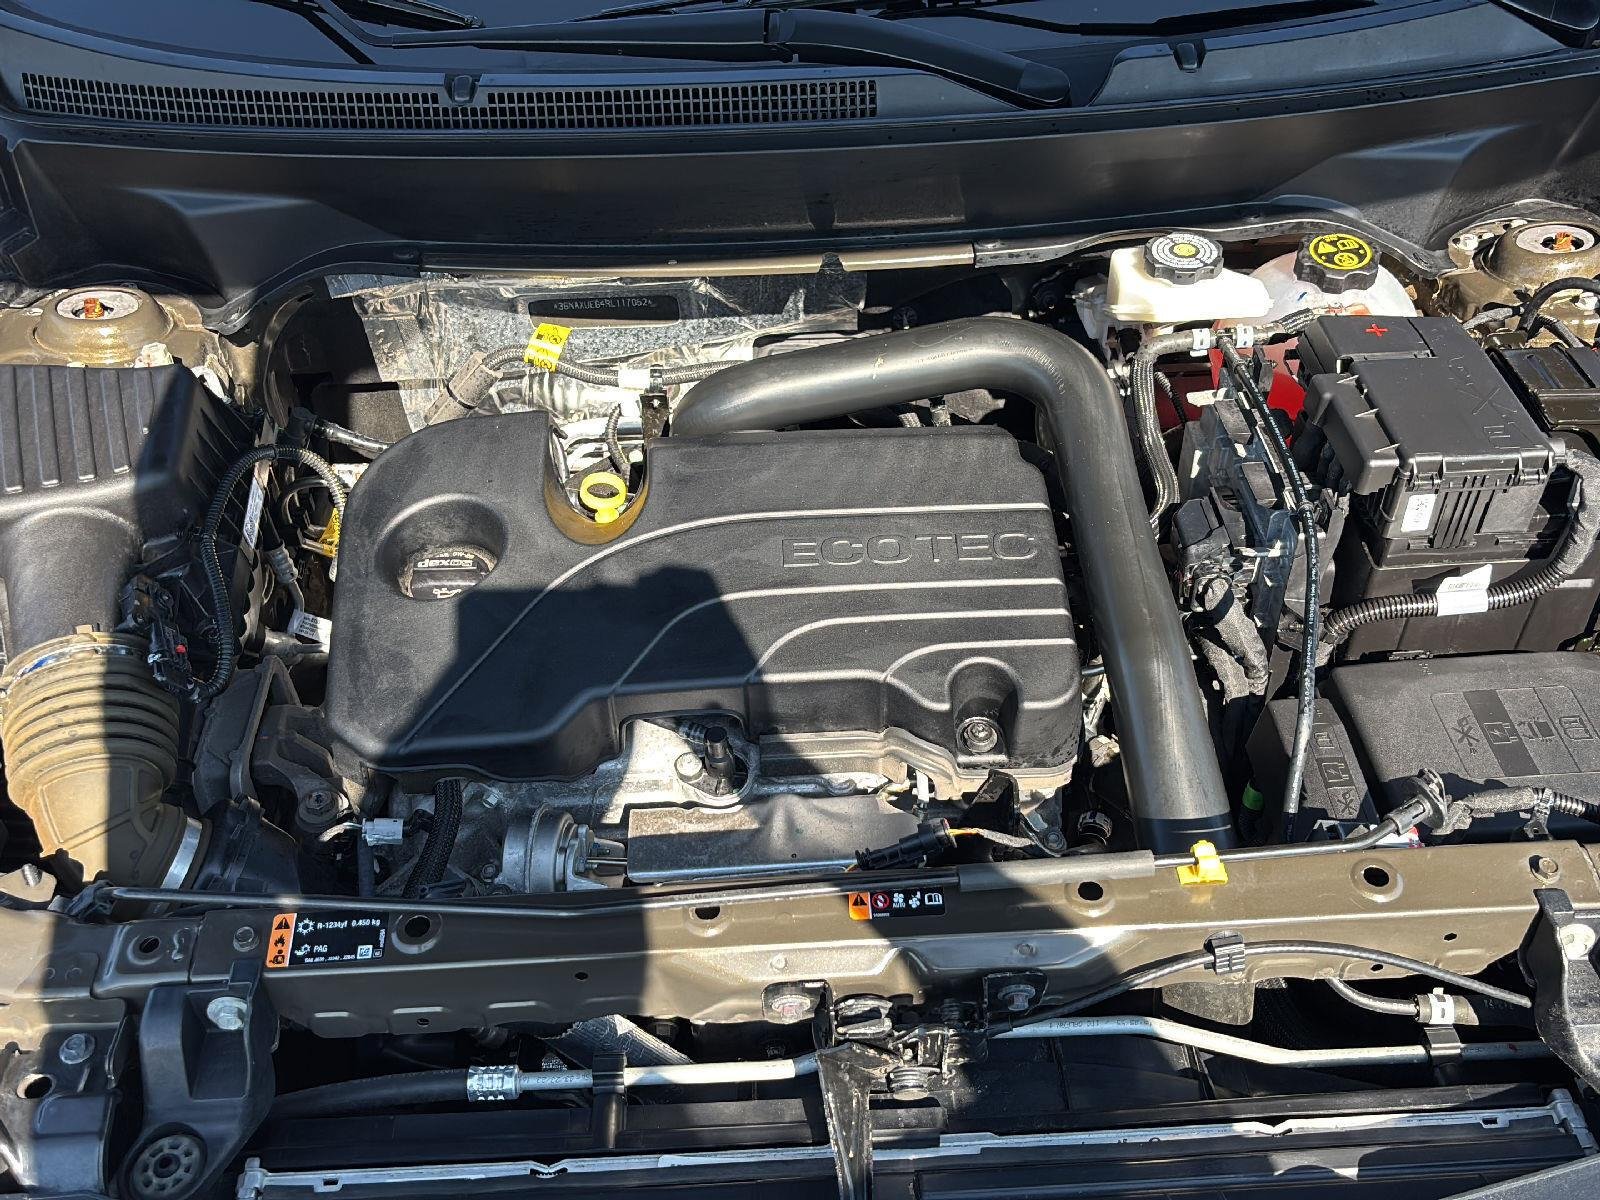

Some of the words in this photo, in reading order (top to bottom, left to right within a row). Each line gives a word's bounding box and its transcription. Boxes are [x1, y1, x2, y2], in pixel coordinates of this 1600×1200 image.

[782, 533, 1039, 568] ECOTEC
[417, 559, 473, 568] dexos
[317, 920, 348, 929] R-1234yf
[351, 919, 370, 927] 0.450
[371, 918, 381, 926] kg
[313, 944, 328, 953] PAG
